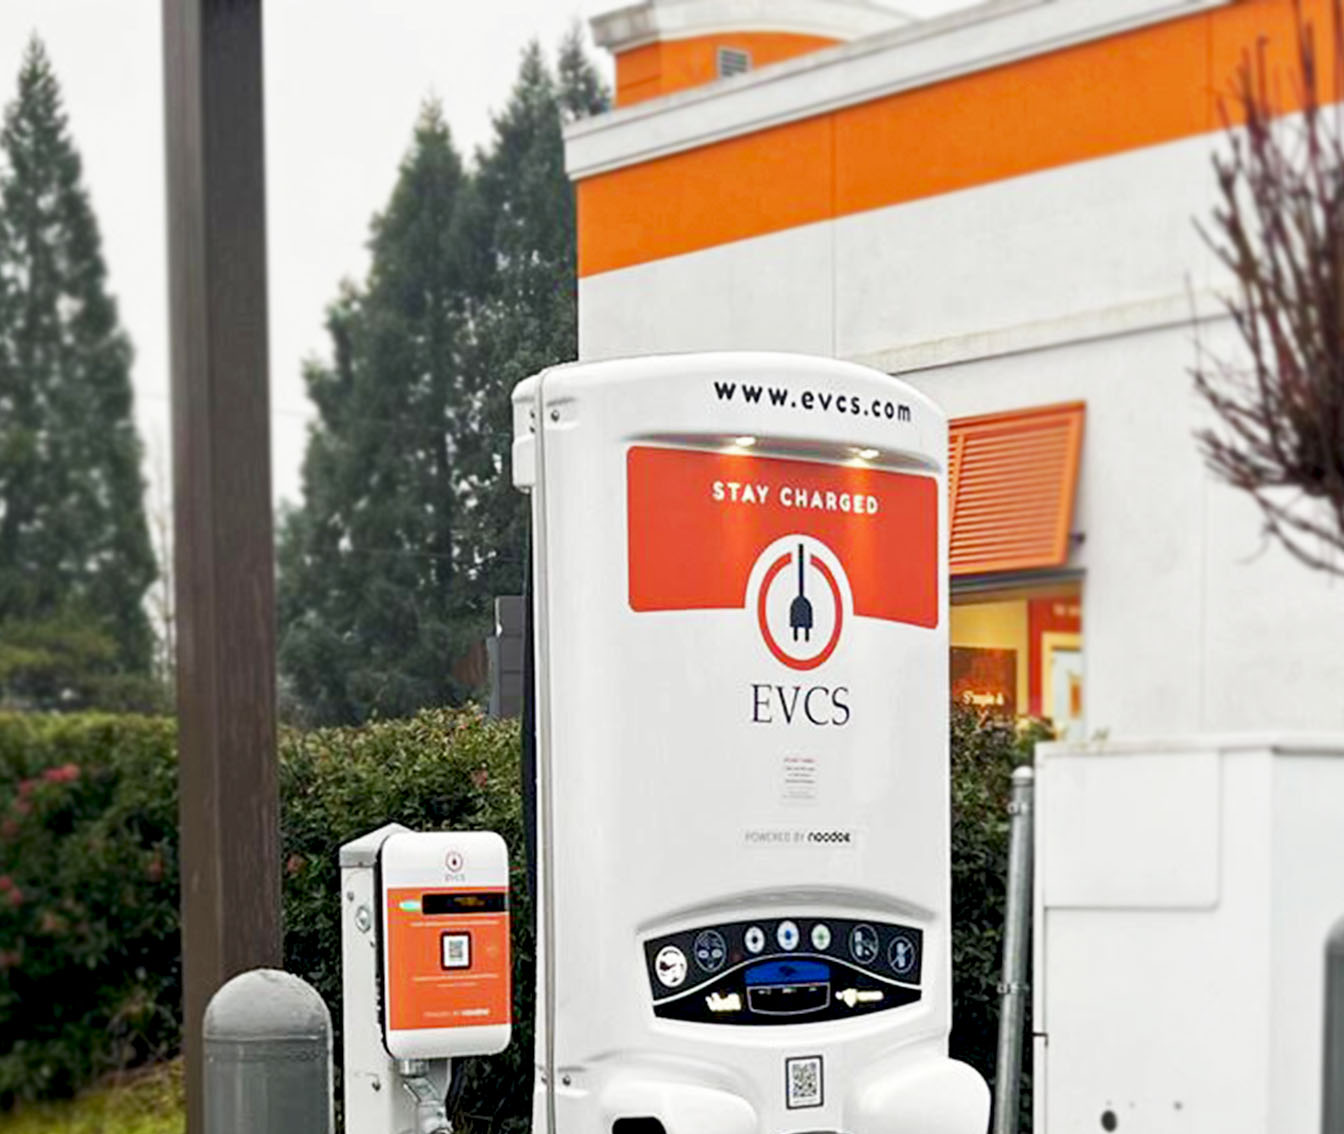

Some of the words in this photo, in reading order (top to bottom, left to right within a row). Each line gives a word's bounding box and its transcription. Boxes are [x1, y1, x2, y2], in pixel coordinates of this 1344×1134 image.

[713, 380, 912, 423] www.evcs.com
[712, 481, 769, 504] STAY
[779, 486, 880, 515] CHARGED
[750, 683, 851, 726] EVCS
